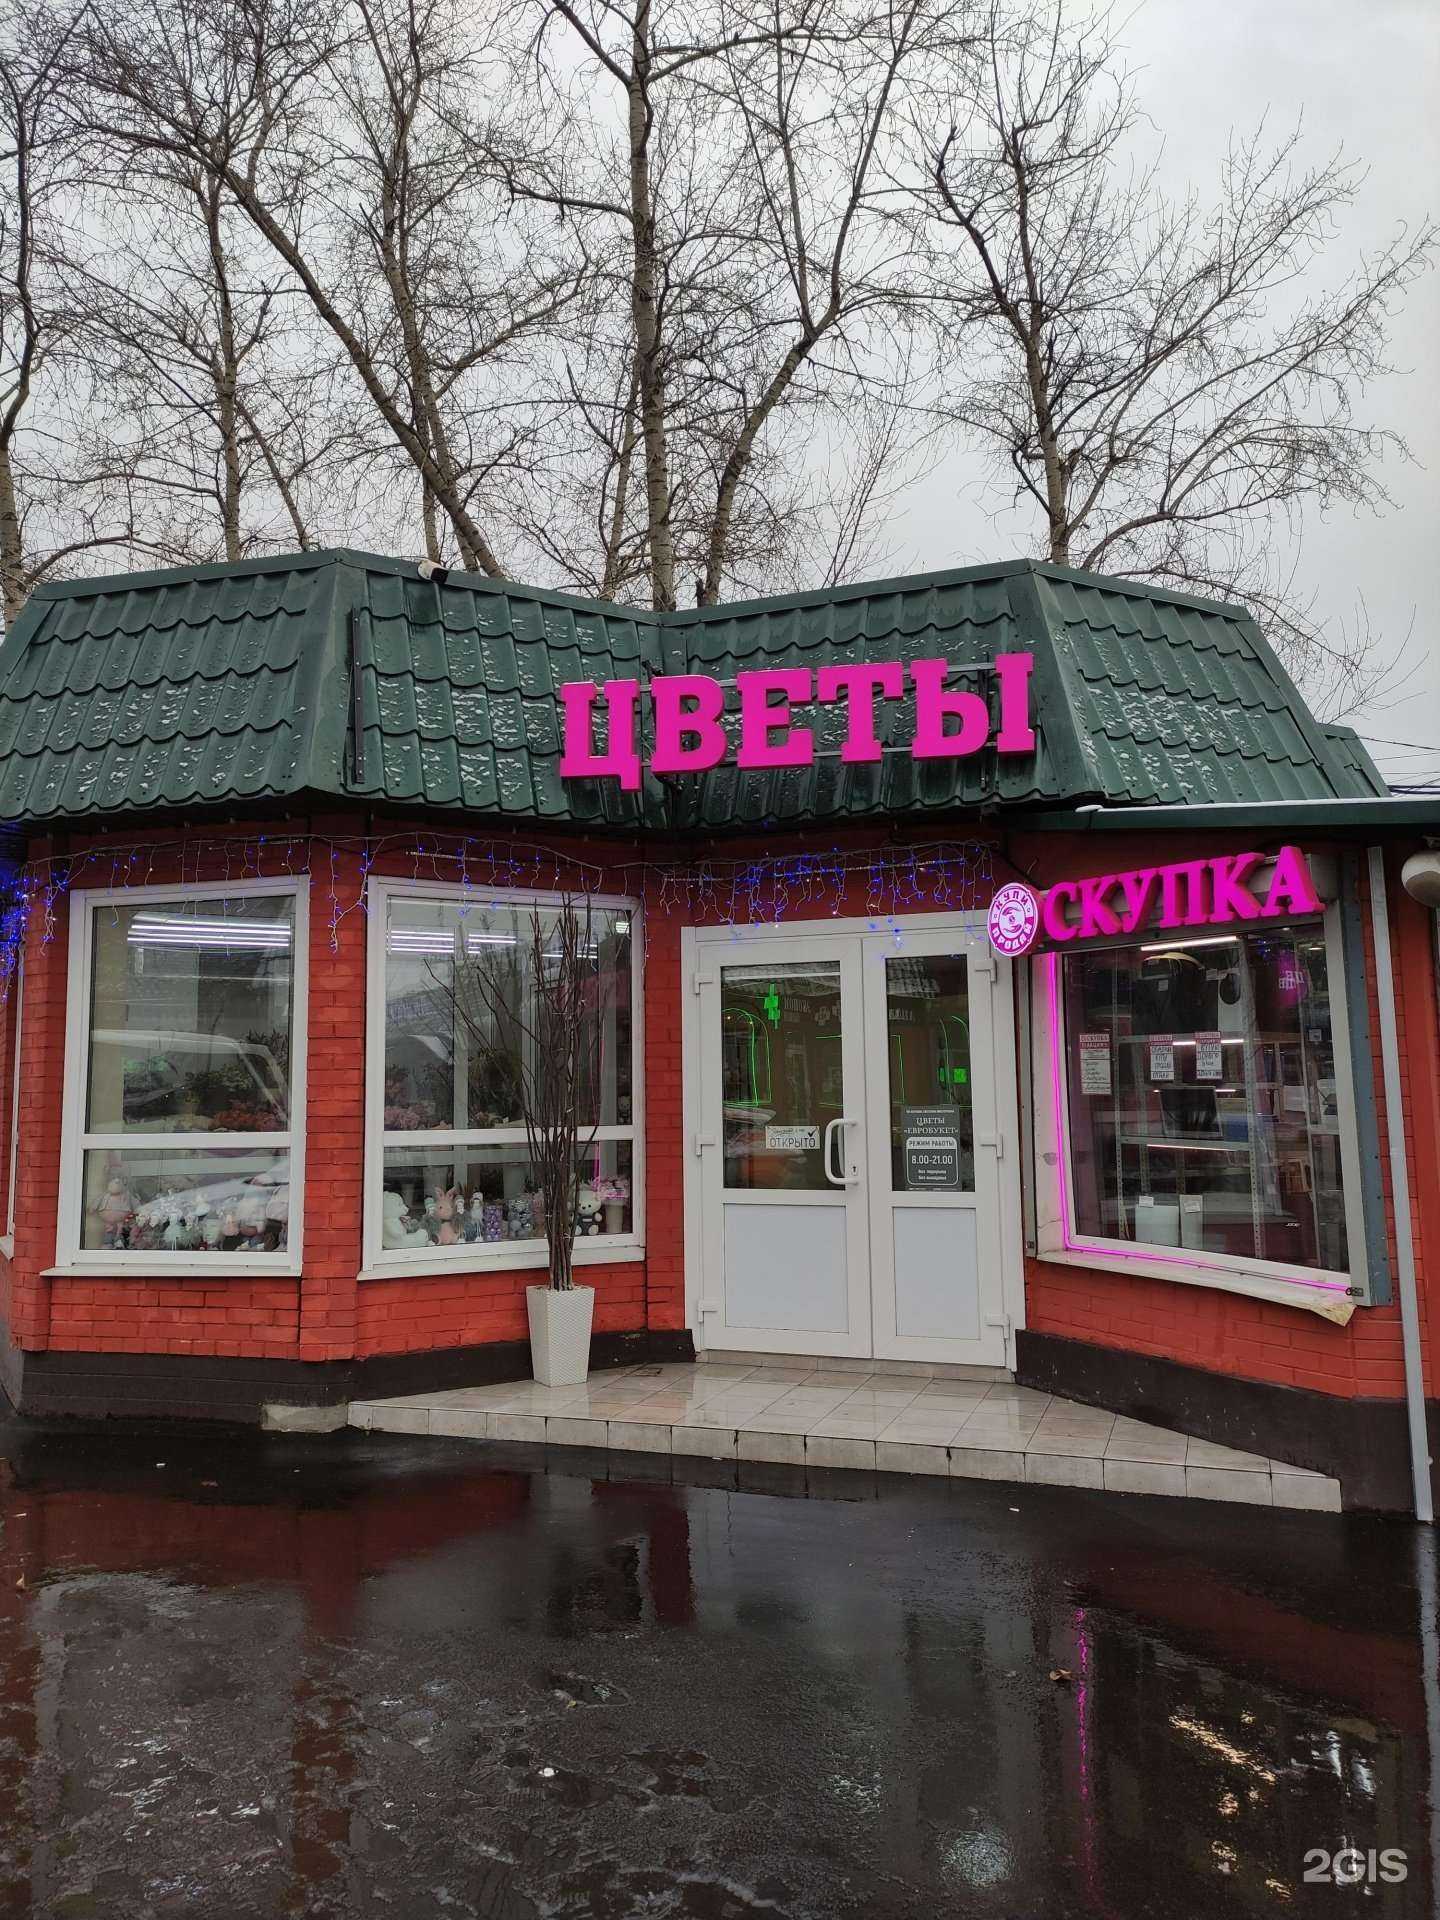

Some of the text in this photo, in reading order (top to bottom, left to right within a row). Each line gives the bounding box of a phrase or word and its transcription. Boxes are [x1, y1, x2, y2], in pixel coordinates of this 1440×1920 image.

[560, 652, 1035, 792] ЦВЕТЫ
[995, 890, 1029, 910] КУПИ
[1042, 846, 1326, 942] СКУПКА
[916, 1117, 945, 1126] ЦВЕТЫ
[769, 1137, 816, 1148] ОТКРЫТО
